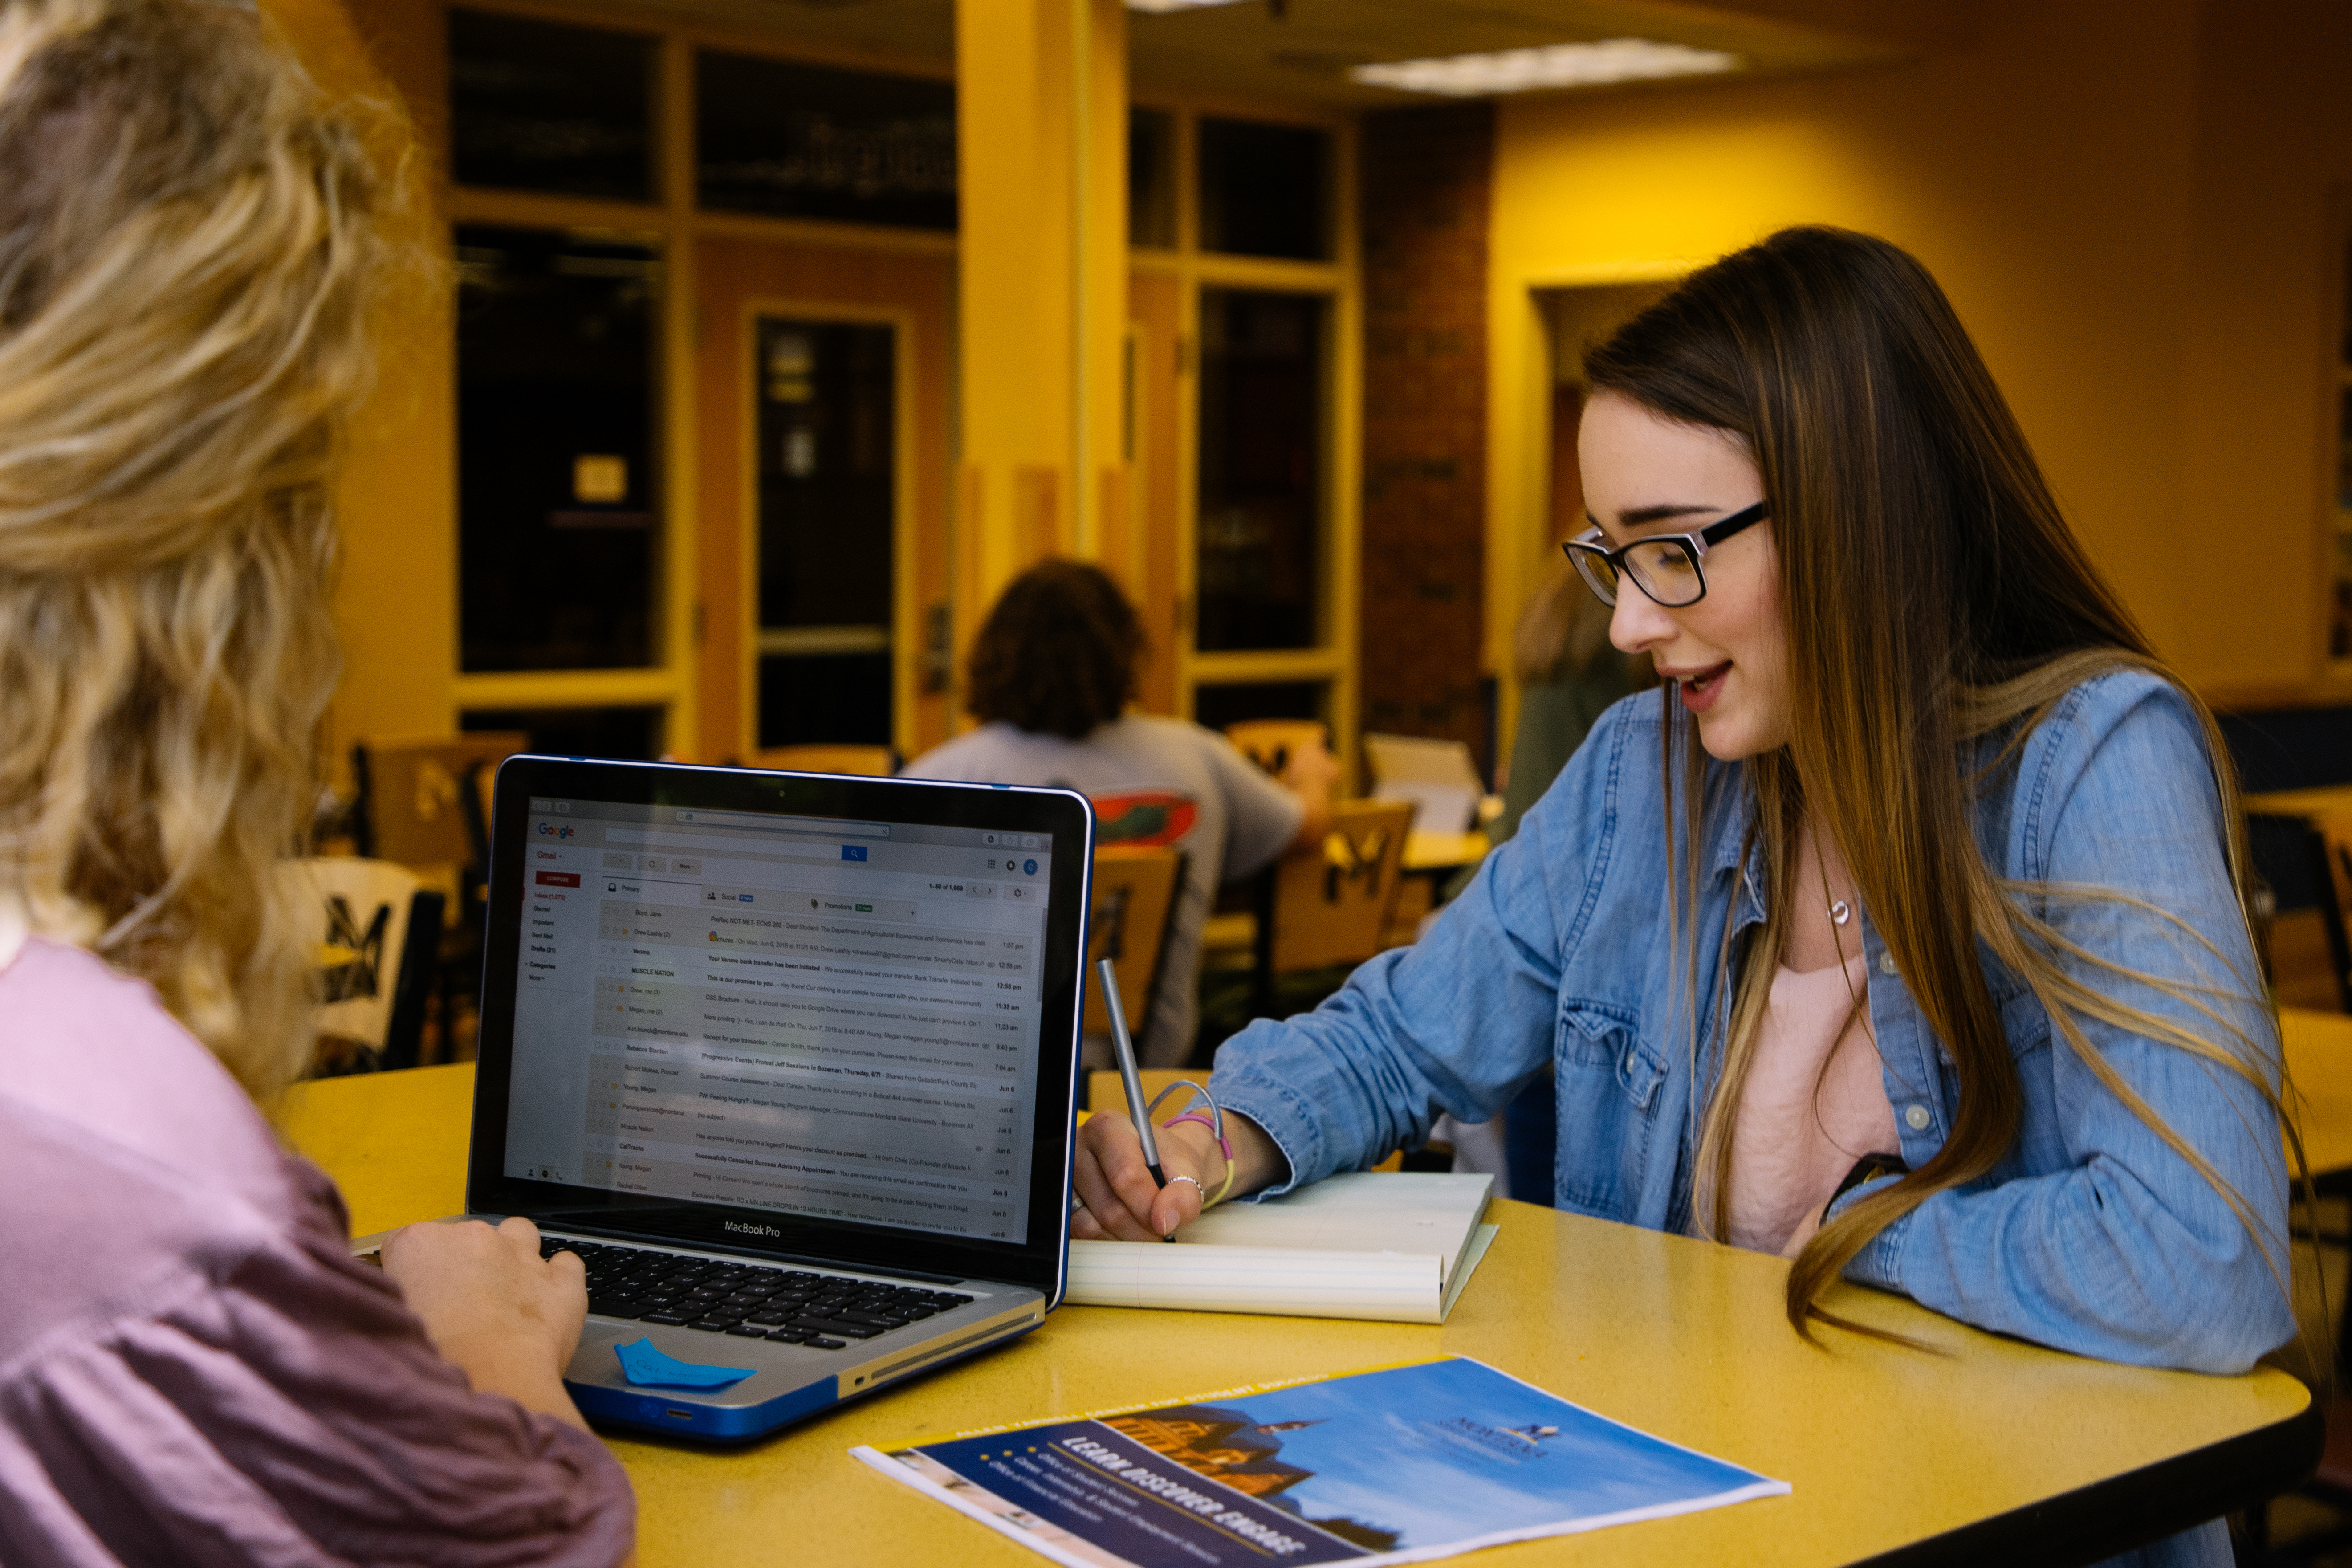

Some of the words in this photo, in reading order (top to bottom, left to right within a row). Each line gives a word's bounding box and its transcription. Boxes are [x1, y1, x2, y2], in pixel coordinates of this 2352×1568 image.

[538, 822, 574, 839] Google
[537, 851, 557, 859] Gmail
[621, 884, 640, 893] Primary
[721, 892, 737, 900] Social
[824, 902, 852, 910] Promotions
[533, 919, 554, 927] Important
[710, 916, 728, 924] PreReq
[529, 961, 556, 970] Categories
[799, 963, 820, 971] initiated
[734, 977, 756, 986] promise
[718, 995, 740, 1003] Brochure
[628, 1006, 646, 1014] Megan,
[717, 1014, 735, 1024] printing
[702, 1033, 721, 1042] Receipt
[741, 1037, 767, 1046] transaction
[626, 1044, 647, 1052] Rebecca
[648, 1046, 668, 1054] Stanton
[701, 1052, 734, 1063] [Progressive
[734, 1055, 754, 1065] Events]
[755, 1058, 774, 1066] Protest
[785, 1061, 810, 1070] Sessions
[843, 1067, 870, 1078] Thursday,
[700, 1072, 720, 1080] Summer
[721, 1075, 739, 1083] Course
[739, 1077, 769, 1086] Assessment
[640, 1085, 656, 1094] Megan
[709, 1093, 727, 1102] Feeling
[728, 1095, 748, 1105] Hungry?
[697, 1112, 705, 1120] (no
[706, 1112, 725, 1122] subject)
[620, 1123, 637, 1131] Muscle
[619, 1142, 645, 1151] CatTracks
[706, 1134, 724, 1143] anyone
[765, 1140, 785, 1150] legend?
[635, 1164, 651, 1173] Megan
[694, 1152, 727, 1163] Successfully
[728, 1156, 753, 1165] Cancelled
[754, 1159, 776, 1168] Success
[777, 1162, 800, 1172] Advising
[801, 1165, 835, 1176] Appointment
[693, 1171, 711, 1181] Printing
[725, 1221, 764, 1235] MacBook
[766, 1226, 780, 1238] Pro
